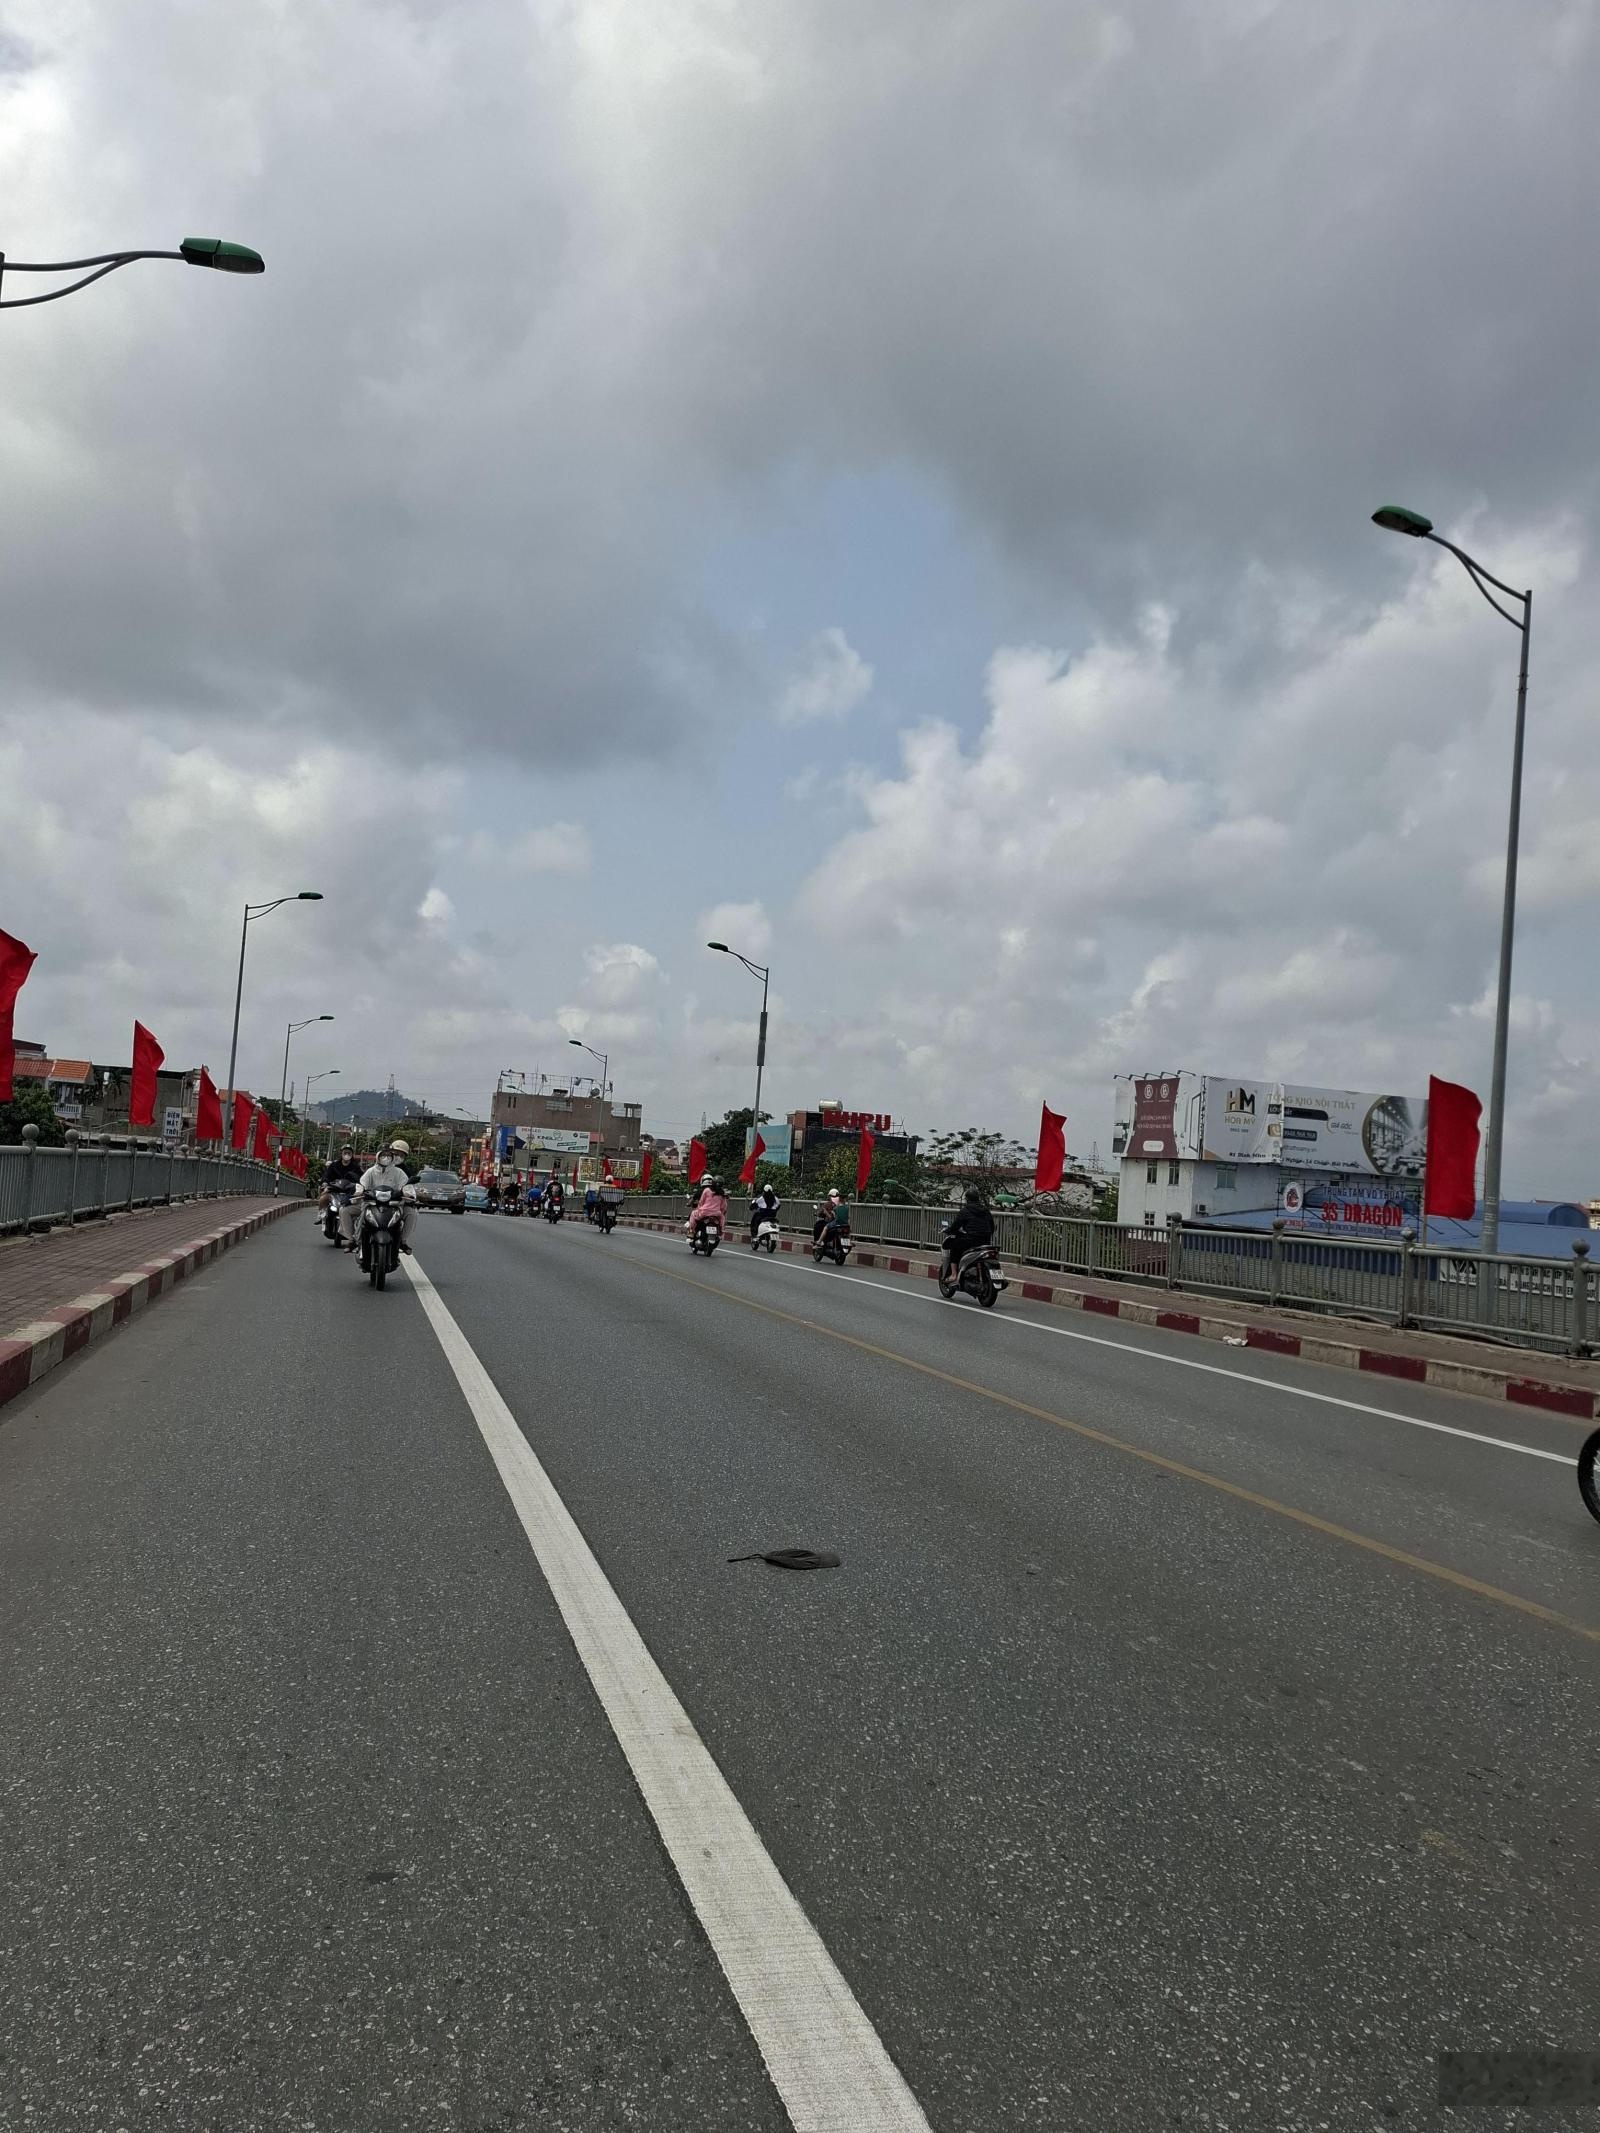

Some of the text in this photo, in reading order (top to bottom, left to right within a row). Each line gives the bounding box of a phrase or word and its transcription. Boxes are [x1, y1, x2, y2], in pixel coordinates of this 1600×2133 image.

[1322, 1186, 1347, 1197] TRUNG
[1321, 1201, 1404, 1227] 3S DRAGON
